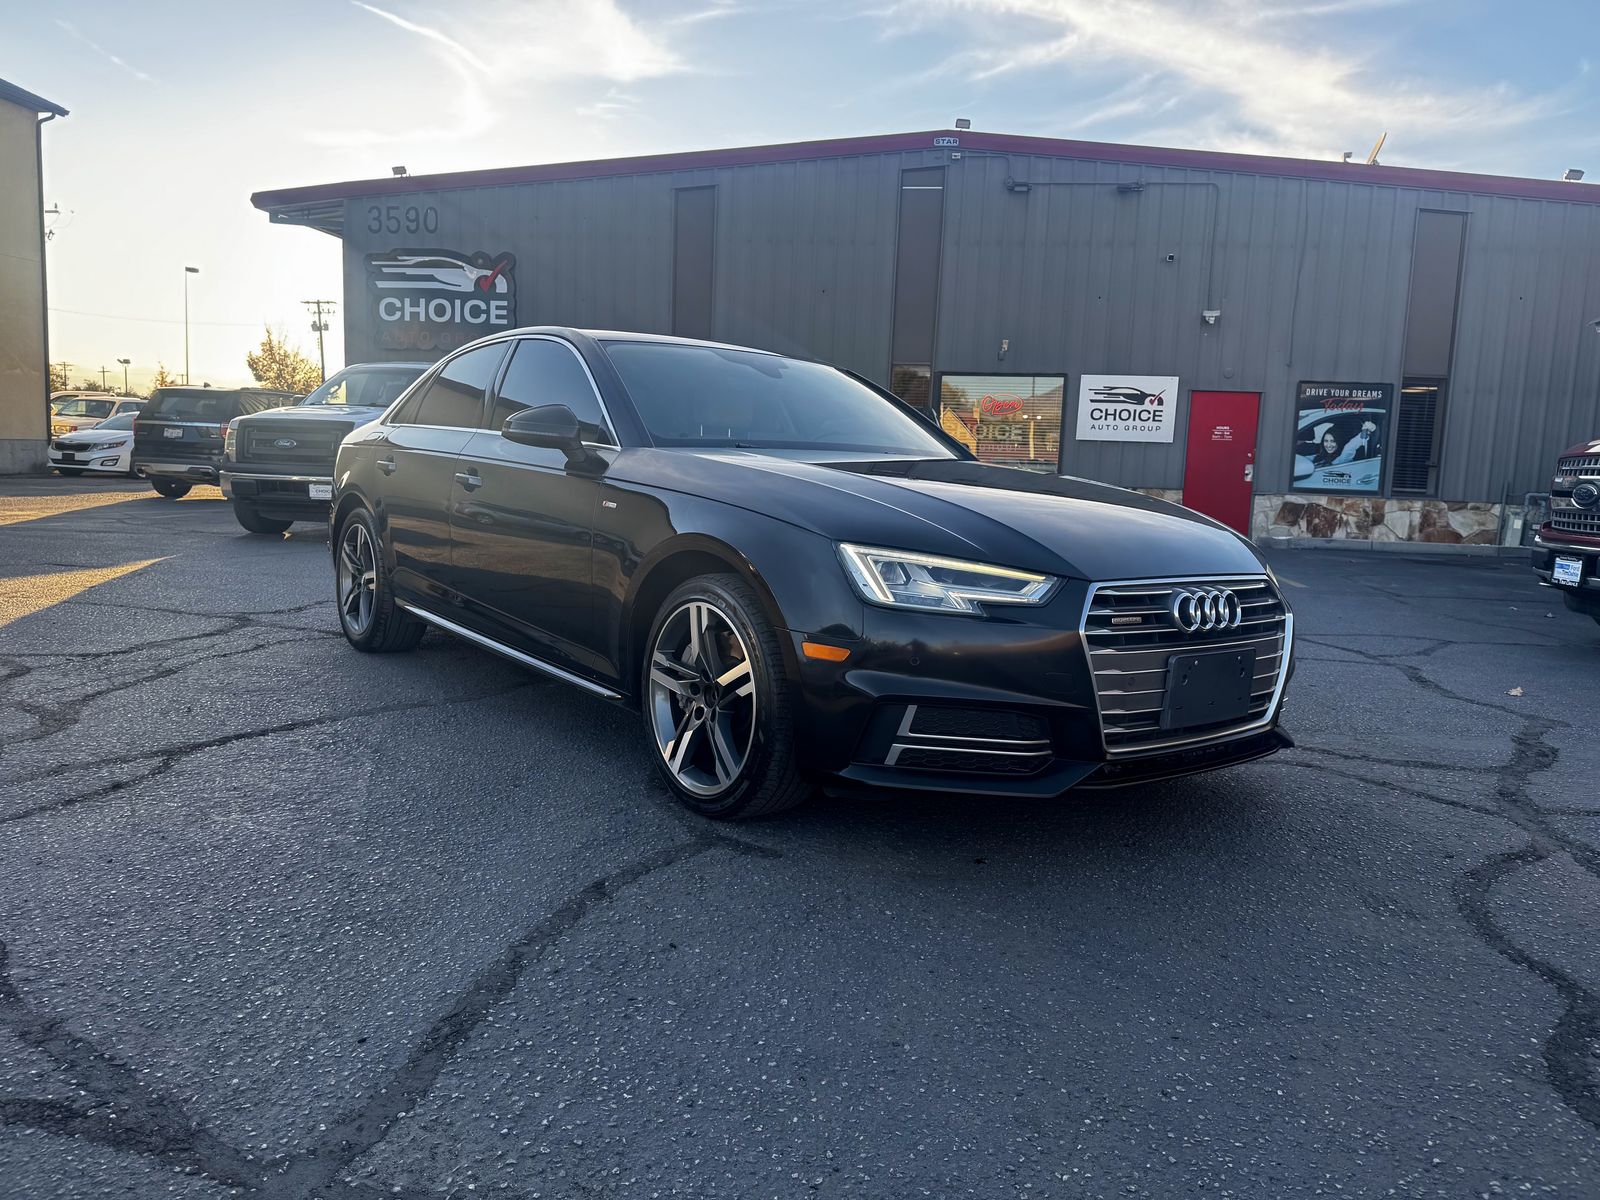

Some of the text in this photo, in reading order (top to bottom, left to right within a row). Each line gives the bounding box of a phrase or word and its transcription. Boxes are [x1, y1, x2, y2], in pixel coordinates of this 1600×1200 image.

[367, 206, 439, 234] 3590
[378, 297, 508, 325] CHOICE
[1305, 388, 1383, 398] DRIVE YOUR DREAMS
[981, 395, 1020, 415] Open
[1090, 408, 1163, 422] CHOICE
